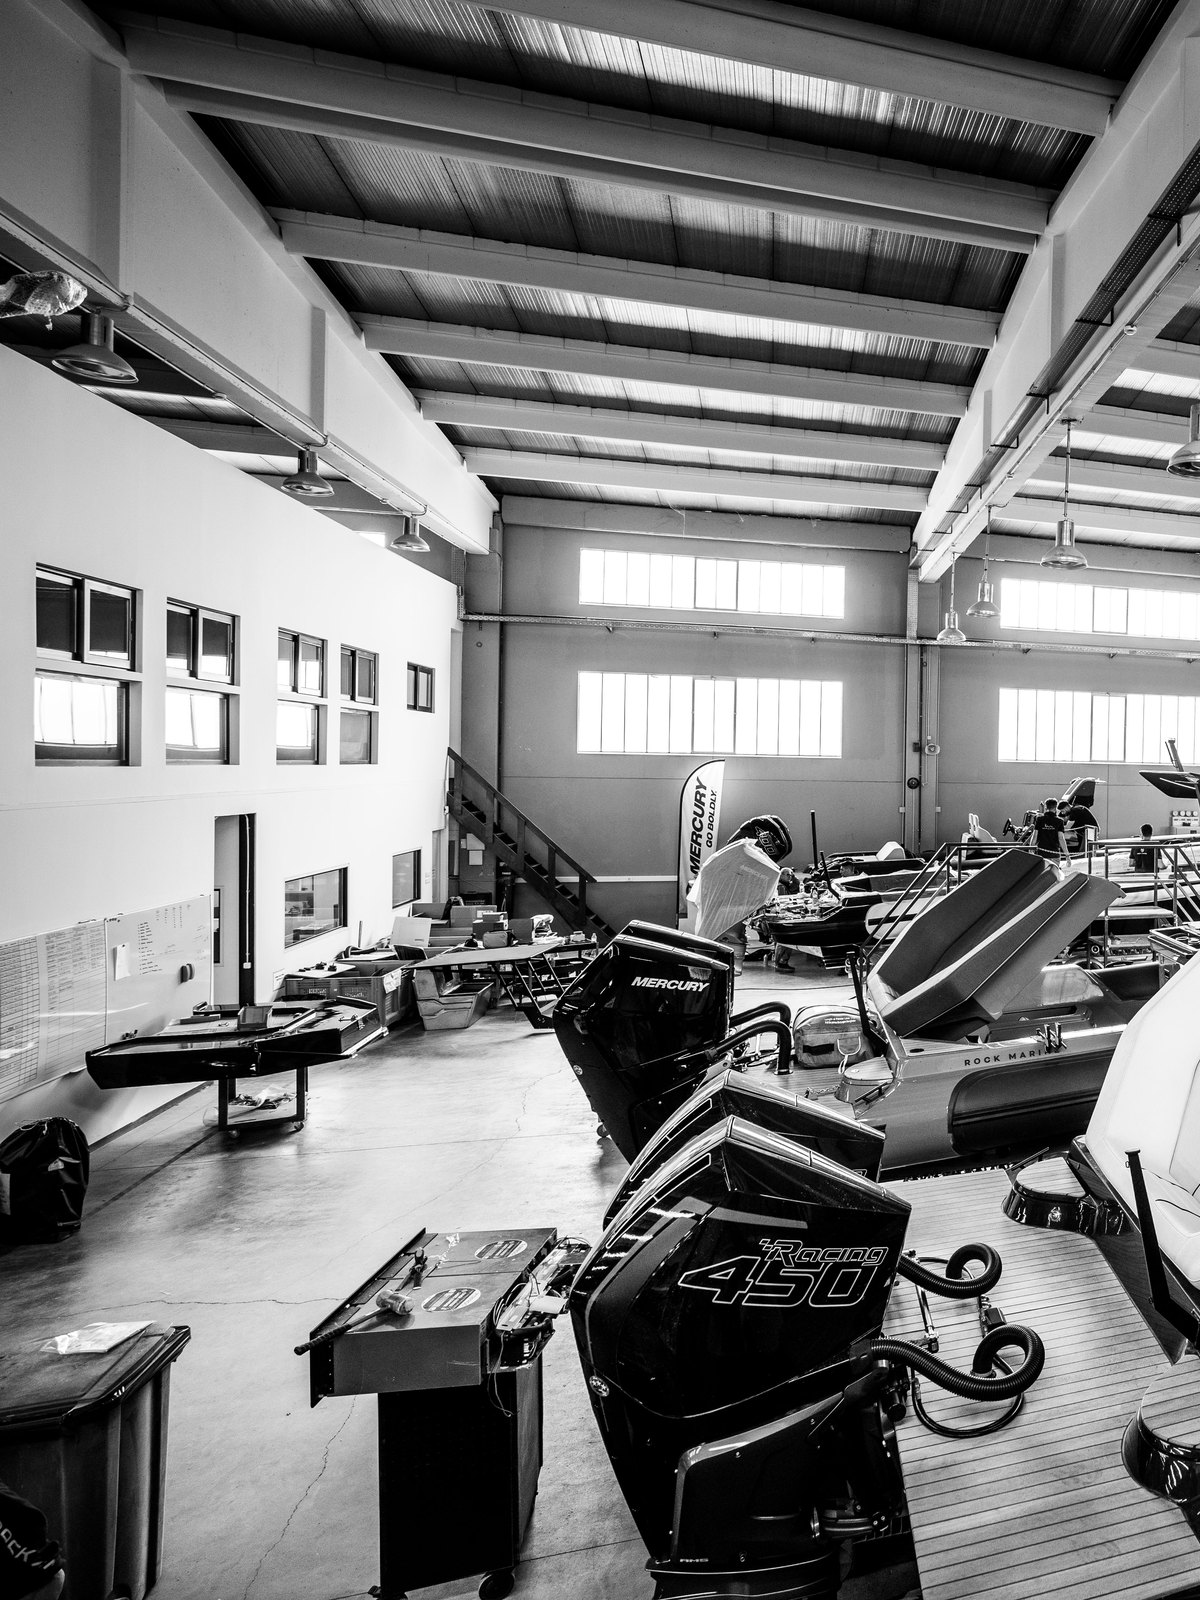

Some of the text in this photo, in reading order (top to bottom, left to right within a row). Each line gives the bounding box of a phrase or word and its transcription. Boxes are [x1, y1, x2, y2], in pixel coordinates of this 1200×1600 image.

[690, 776, 707, 879] MERCURY
[705, 832, 714, 848] GO
[631, 976, 710, 992] MERCURY
[964, 1048, 1060, 1067] ROCK MARI
[760, 1239, 889, 1267] Racing
[677, 1255, 878, 1307] 450
[0, 1520, 37, 1562] OCK
